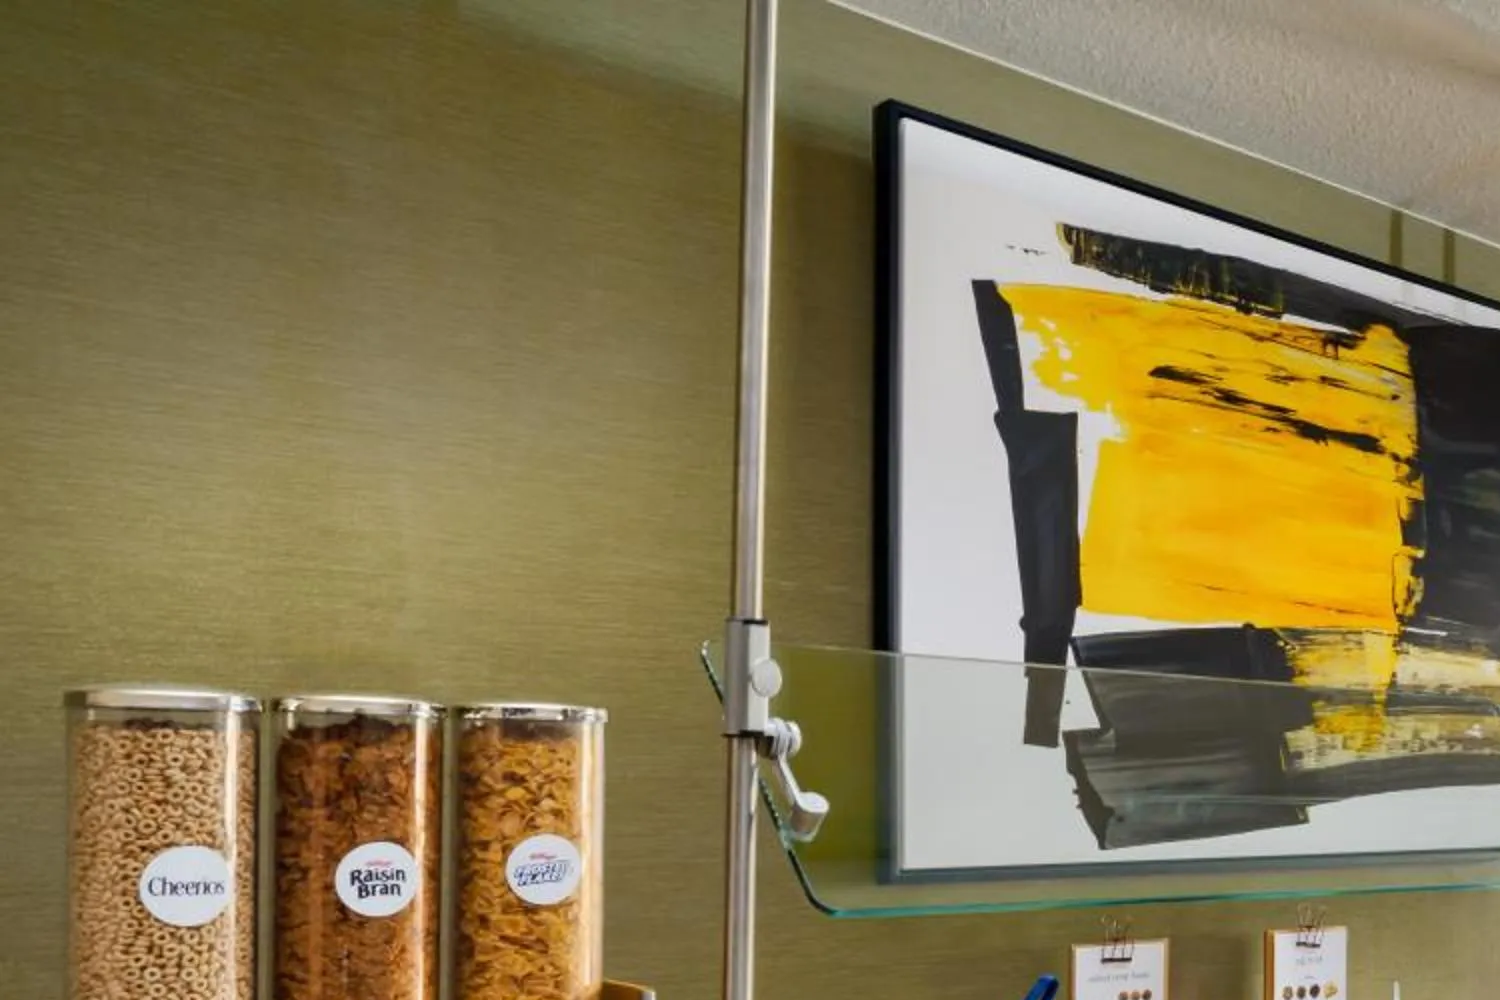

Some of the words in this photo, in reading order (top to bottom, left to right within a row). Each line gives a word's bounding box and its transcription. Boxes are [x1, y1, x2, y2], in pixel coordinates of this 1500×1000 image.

[147, 876, 225, 896] Cheerios
[350, 868, 406, 886] Raisin
[358, 883, 402, 899] Bran
